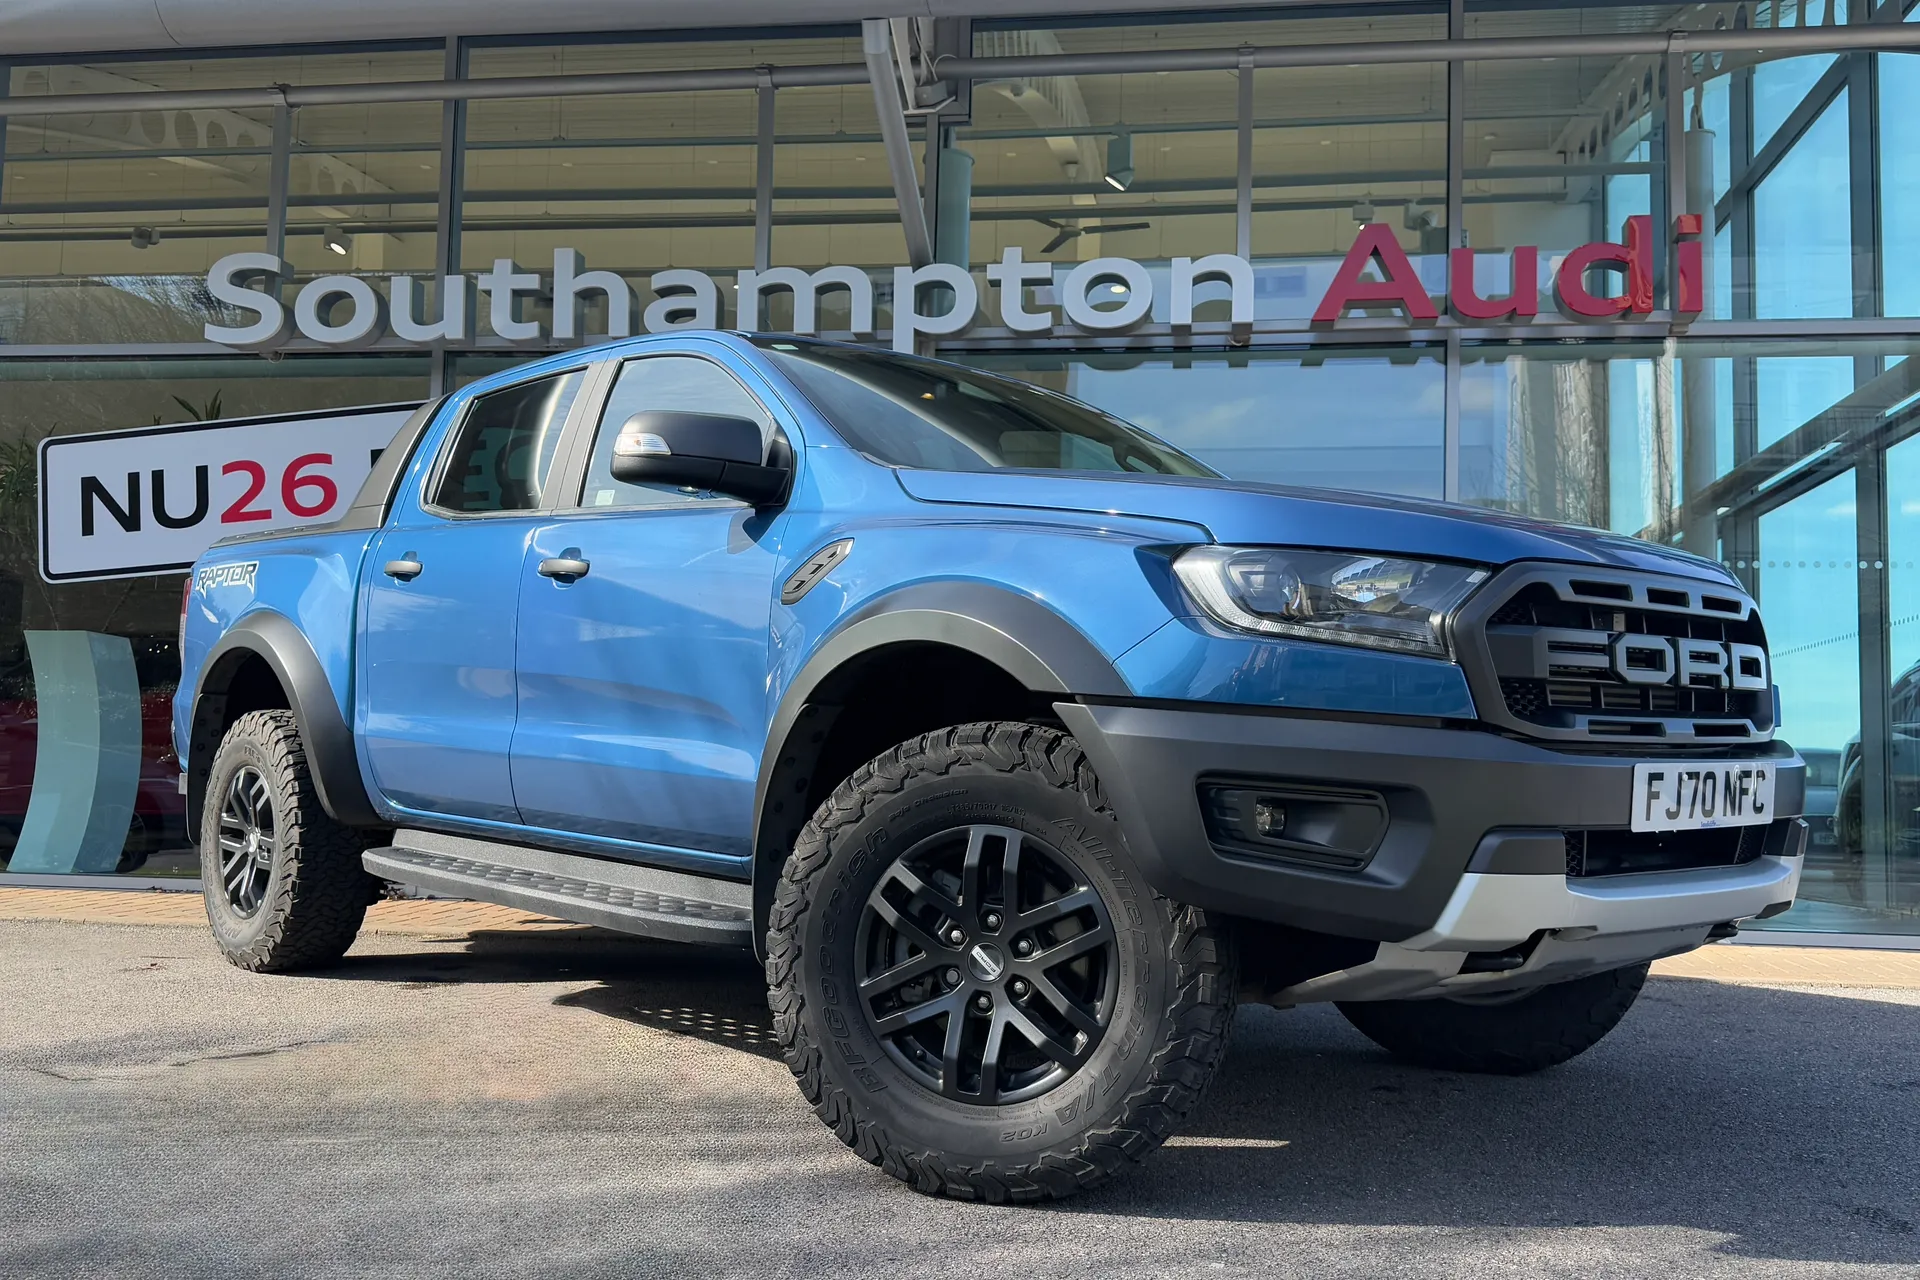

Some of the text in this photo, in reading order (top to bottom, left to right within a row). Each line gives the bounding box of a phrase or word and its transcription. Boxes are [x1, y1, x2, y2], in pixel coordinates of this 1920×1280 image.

[204, 214, 1704, 355] Southampton Audi
[80, 452, 338, 537] NU26
[195, 560, 260, 598] RAPTOR
[1533, 629, 1767, 692] FORD
[1645, 769, 1766, 822] FJ70 NFC
[819, 825, 890, 1095] BFGoodrich
[1051, 817, 1150, 1060] All-Terrain
